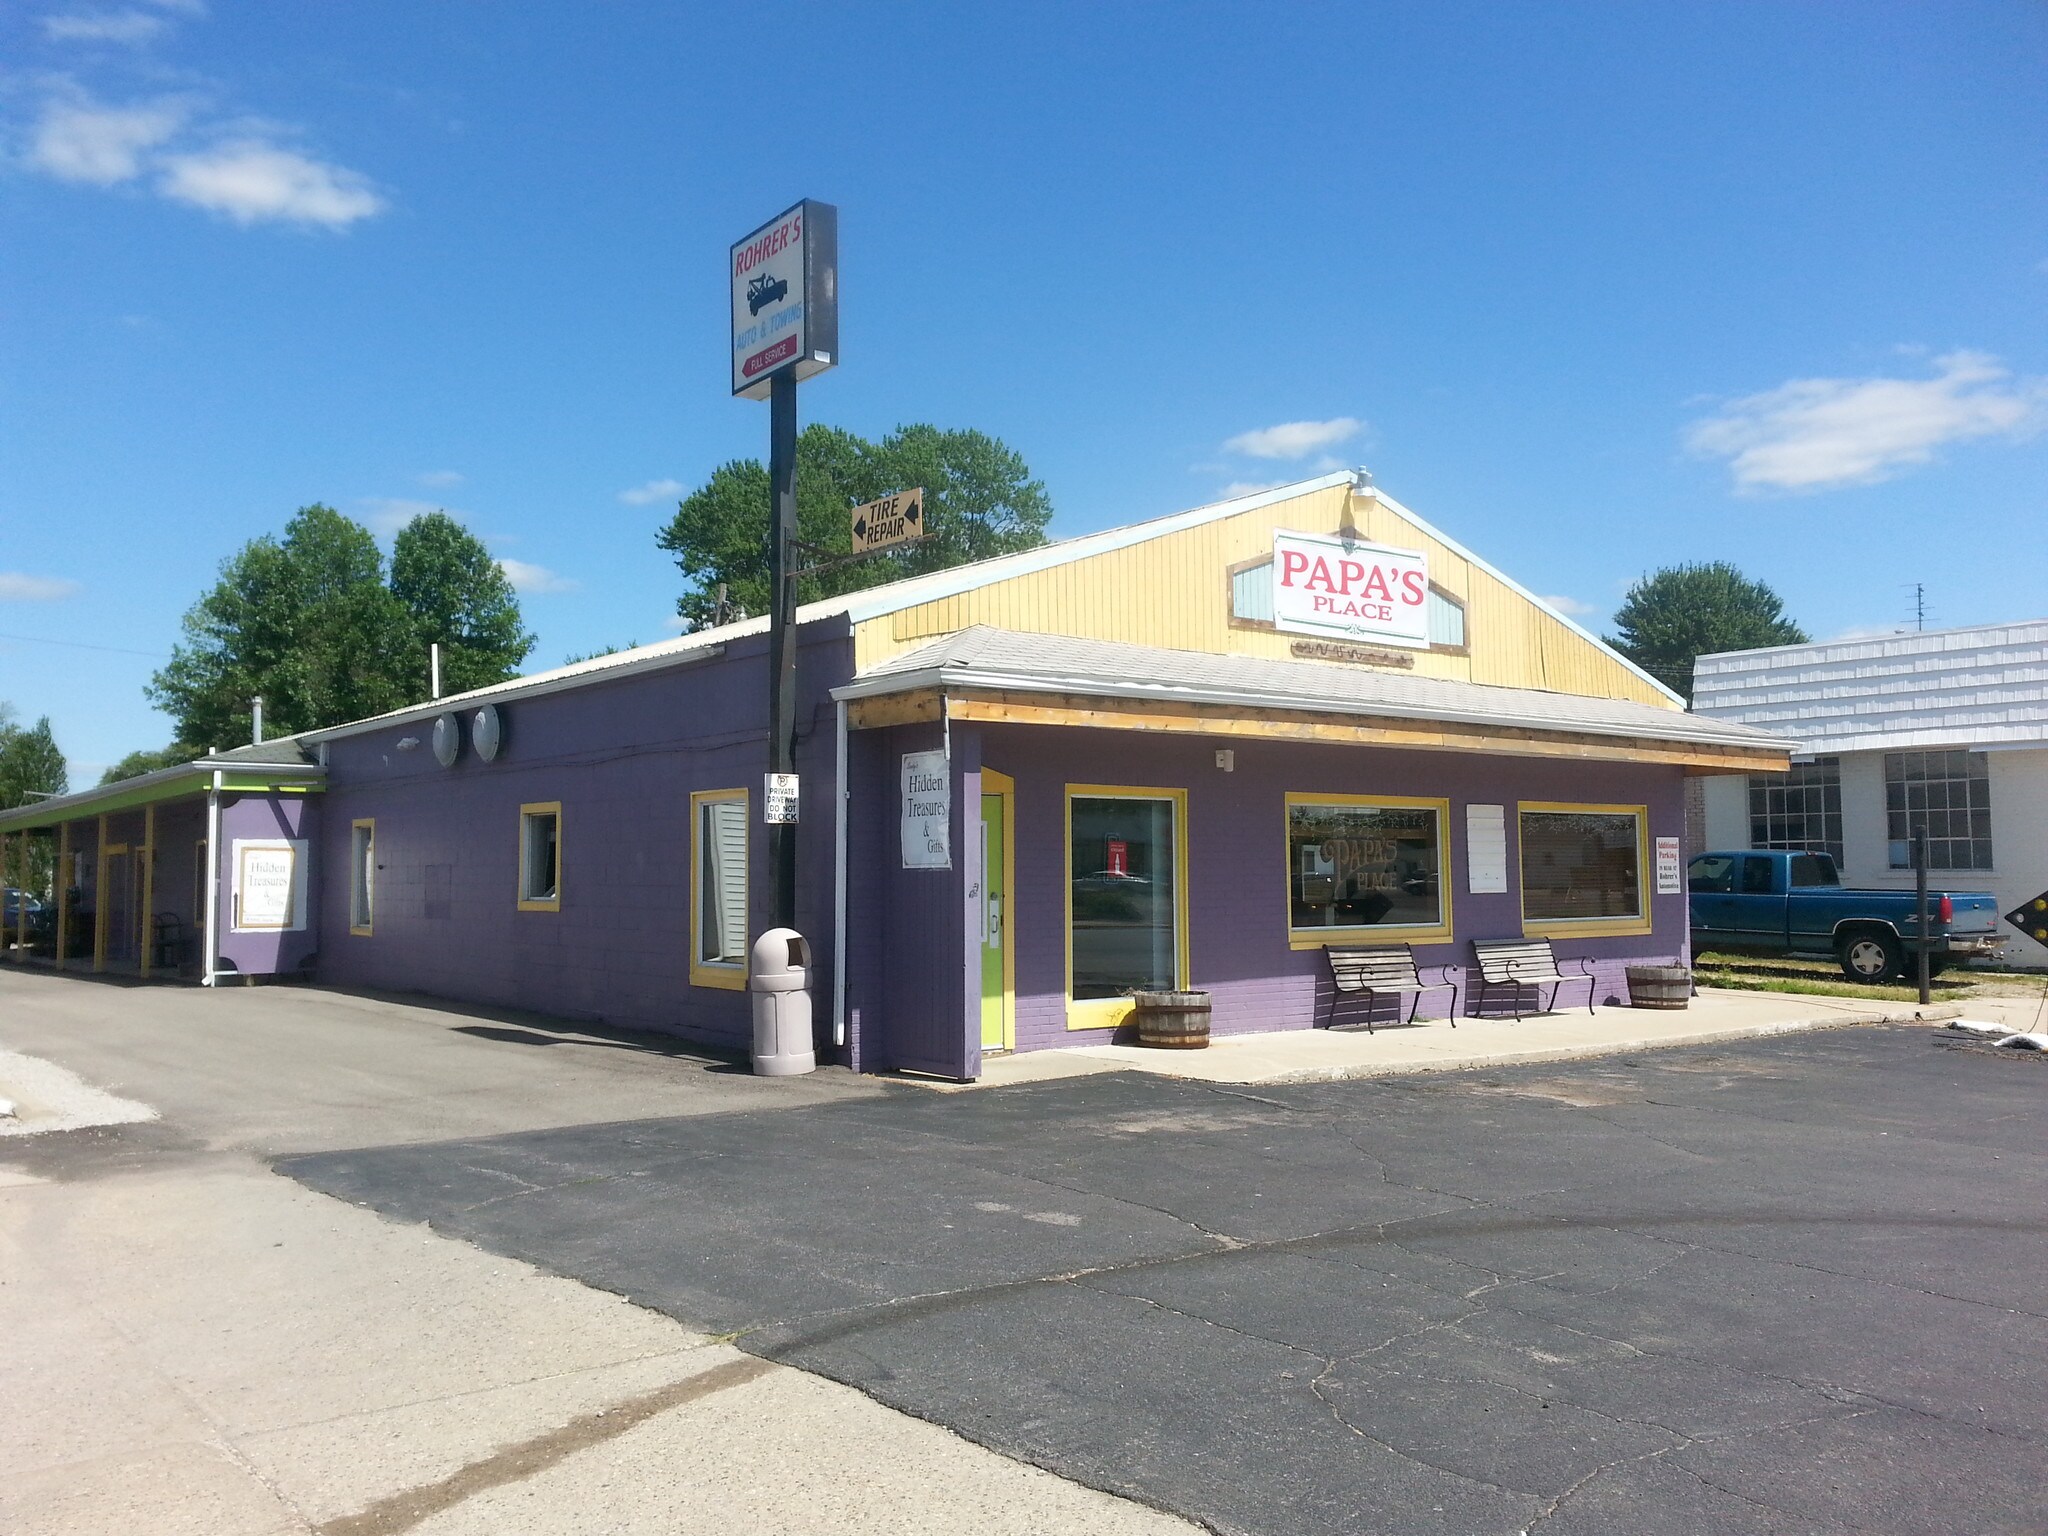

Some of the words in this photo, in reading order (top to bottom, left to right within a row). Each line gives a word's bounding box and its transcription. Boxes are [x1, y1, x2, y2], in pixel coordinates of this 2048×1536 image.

[736, 215, 801, 277] ROHRER'S
[736, 327, 757, 350] AUTO
[760, 321, 767, 338] &
[770, 302, 801, 334] TOWING
[764, 344, 787, 364] SERVICE
[870, 497, 900, 523] TIRE
[866, 517, 905, 545] REPAIR
[1281, 550, 1424, 606] PAPA'S
[1313, 595, 1393, 621] PLACE
[769, 787, 795, 795] PRIVATE
[909, 773, 943, 793] Hidden
[767, 812, 797, 821] BLOCK
[783, 805, 797, 813] NOT
[907, 798, 946, 817] Treasures
[923, 820, 930, 837] &
[927, 839, 944, 854] Gifts
[1658, 851, 1677, 861] Parking
[251, 861, 286, 873] Hidden
[249, 875, 288, 887] Treasures
[1356, 872, 1397, 890] PLACE
